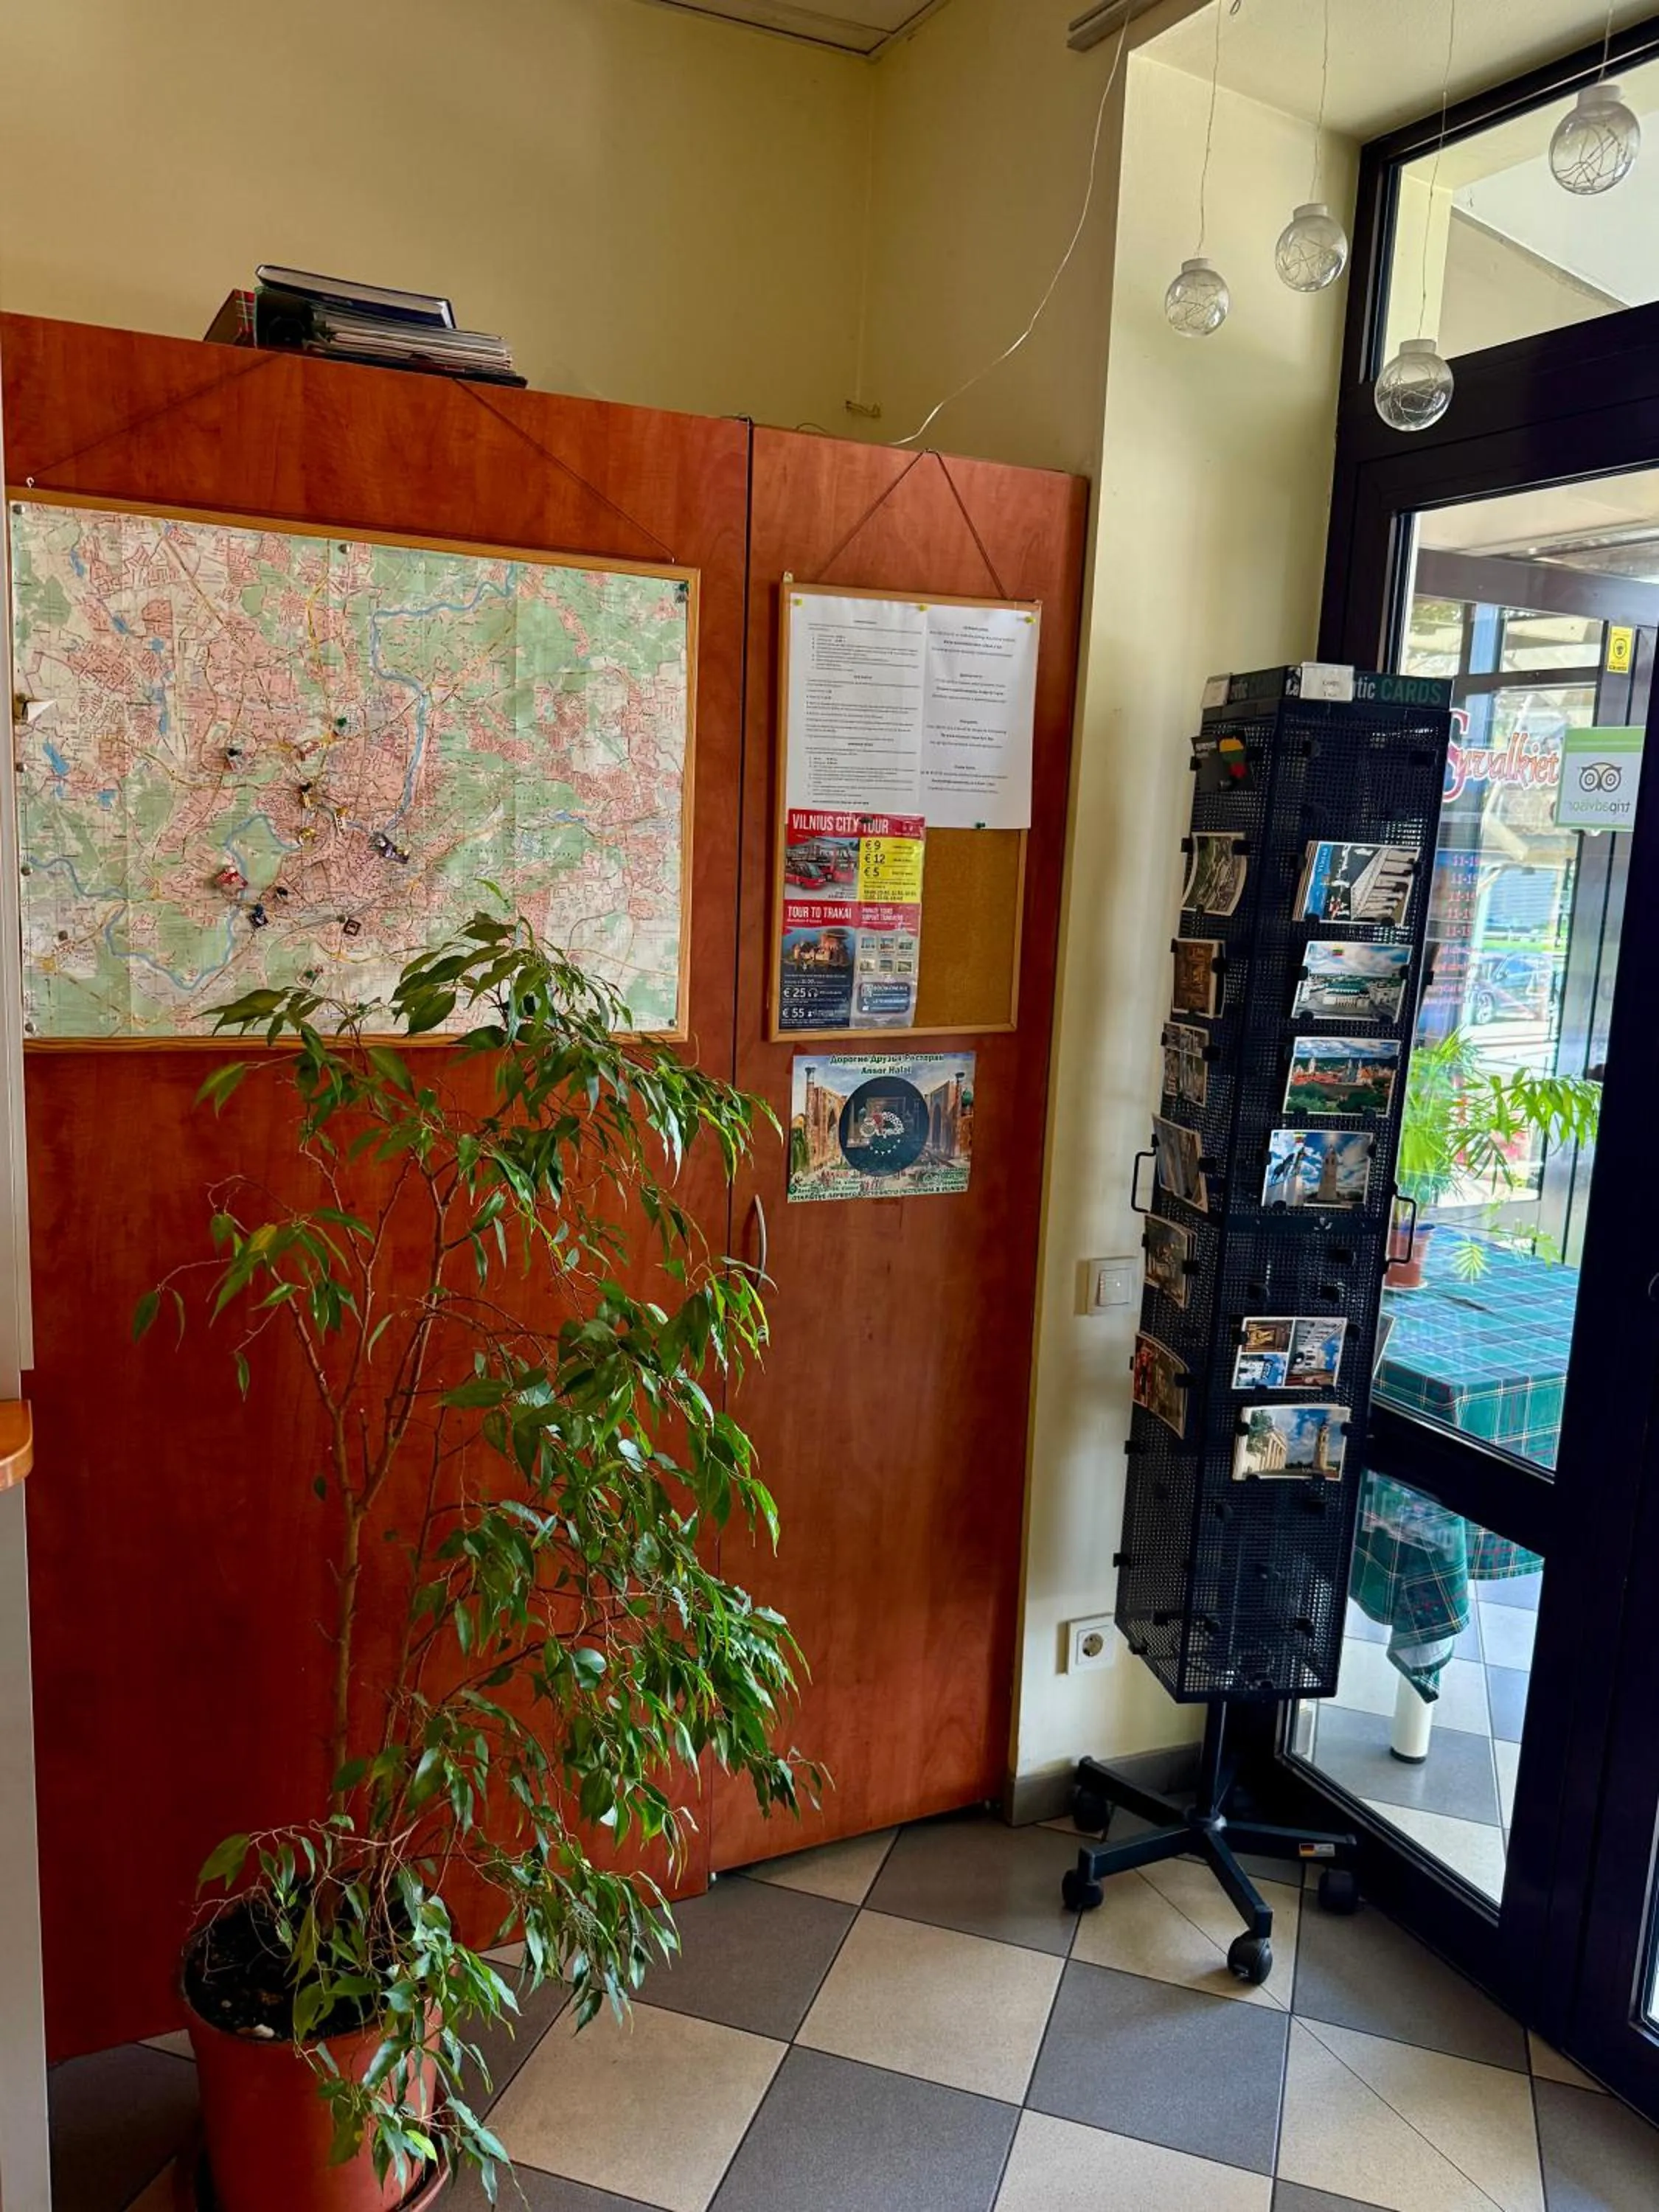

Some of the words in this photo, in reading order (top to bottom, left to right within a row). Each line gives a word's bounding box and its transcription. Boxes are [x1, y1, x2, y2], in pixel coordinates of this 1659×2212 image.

[1380, 679, 1443, 704] CARDS
[1440, 708, 1561, 803] Suvalkiet
[793, 813, 834, 831] VILNIUS
[835, 816, 860, 833] CITY
[787, 906, 810, 918] TOUR
[812, 907, 822, 919] TO
[824, 907, 852, 919] TRAKAI
[793, 987, 807, 998] 25
[791, 1008, 805, 1018] 55
